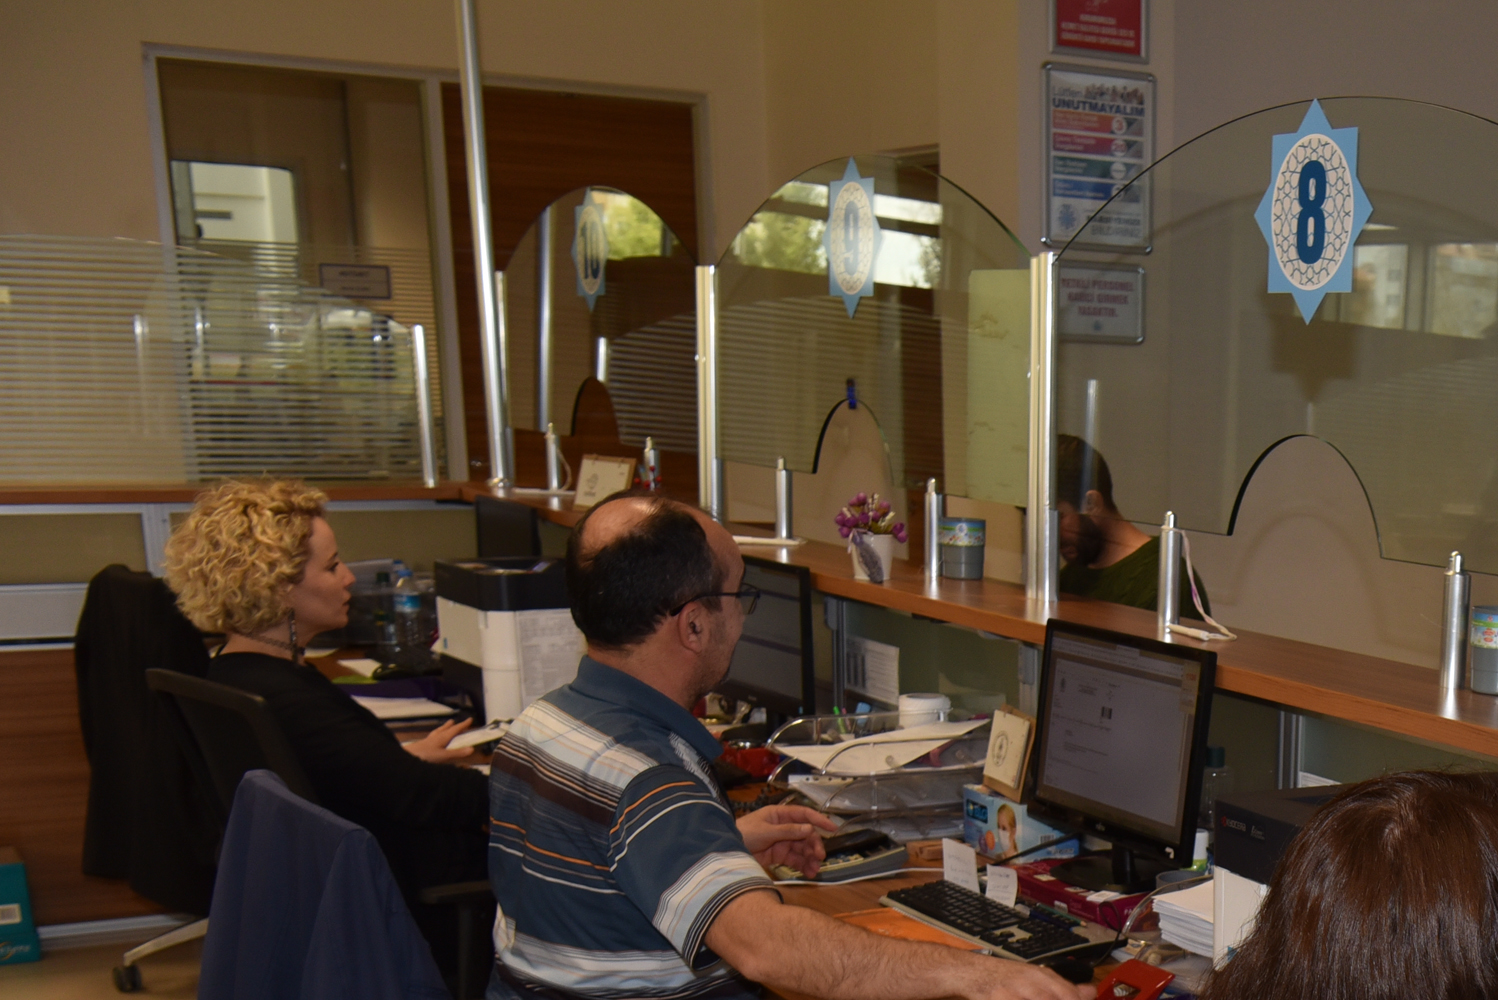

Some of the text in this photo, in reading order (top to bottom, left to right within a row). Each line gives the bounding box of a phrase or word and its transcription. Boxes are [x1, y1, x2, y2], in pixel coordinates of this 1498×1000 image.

[1052, 97, 1146, 118] UNUTMAYALIM
[844, 200, 859, 276] 9
[1297, 160, 1327, 265] 8
[581, 220, 600, 280] 10
